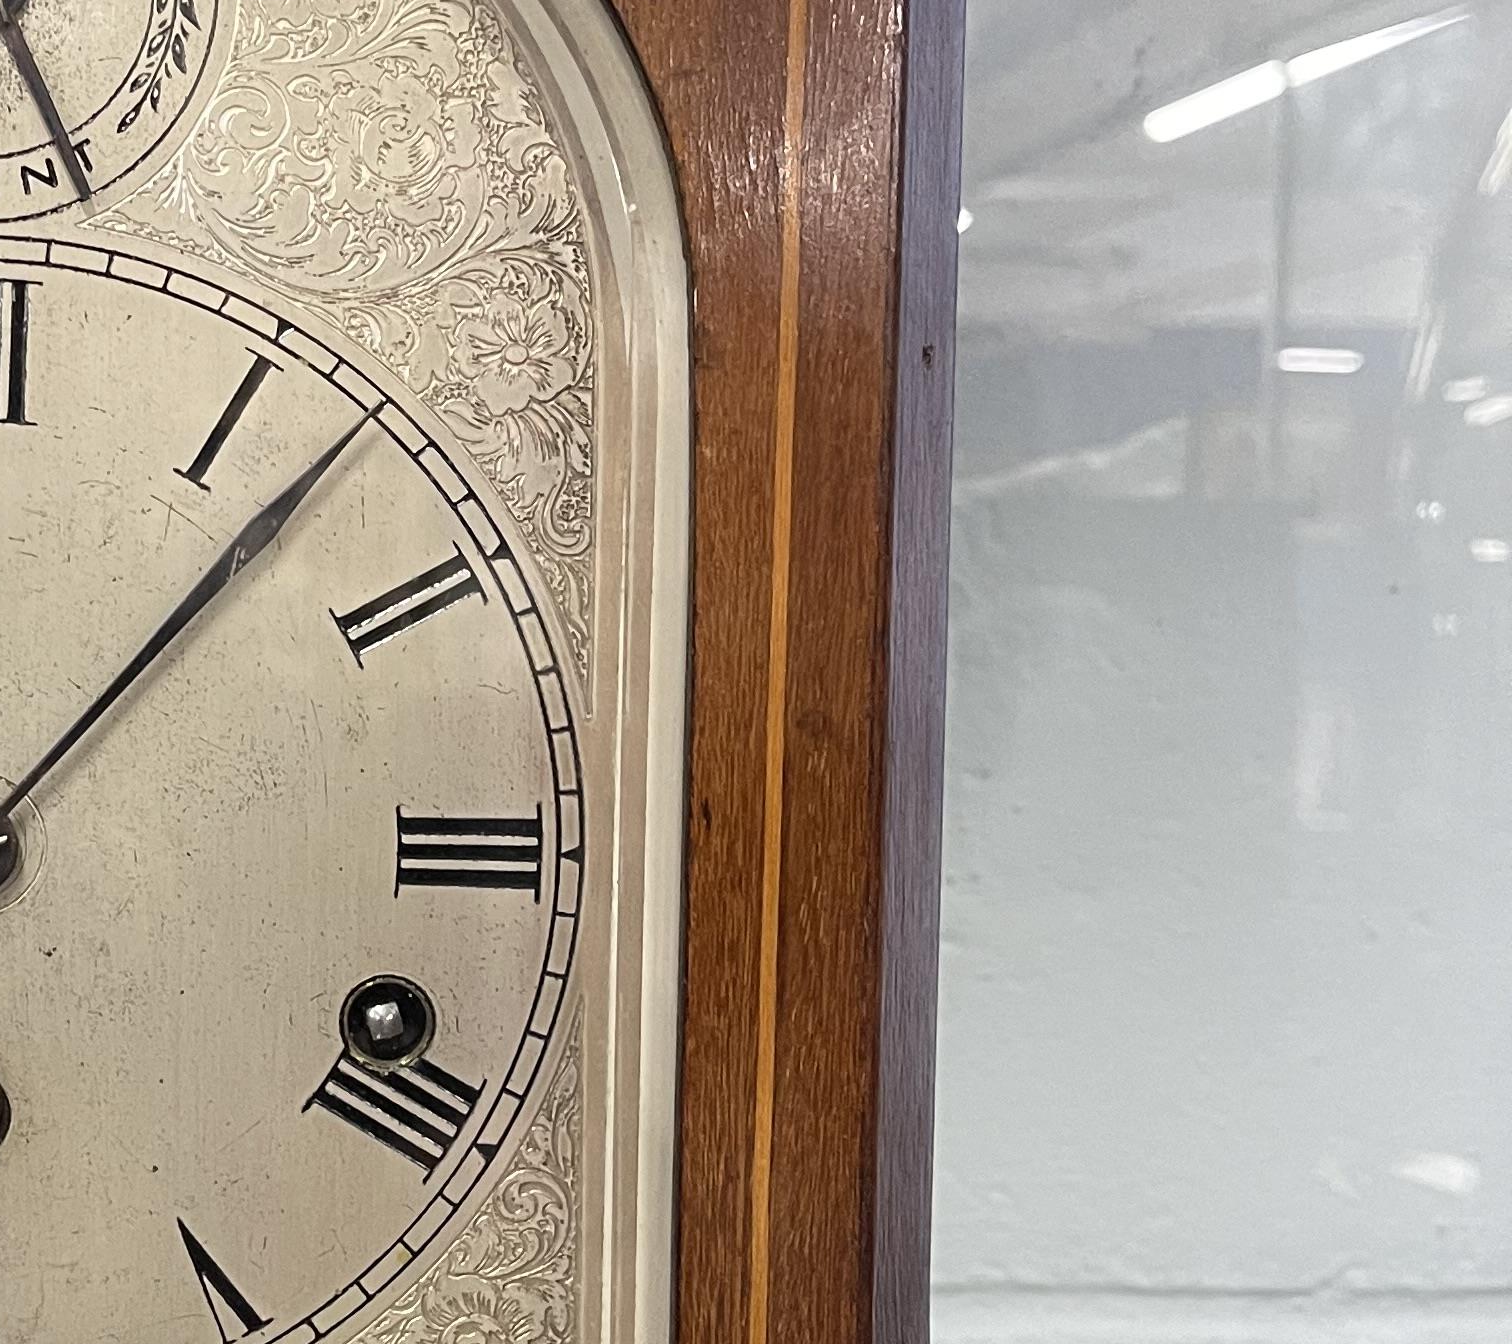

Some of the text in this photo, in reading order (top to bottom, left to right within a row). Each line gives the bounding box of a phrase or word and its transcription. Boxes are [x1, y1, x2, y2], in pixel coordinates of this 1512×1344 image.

[173, 347, 284, 491] I
[329, 541, 488, 669] II
[395, 802, 541, 904] III
